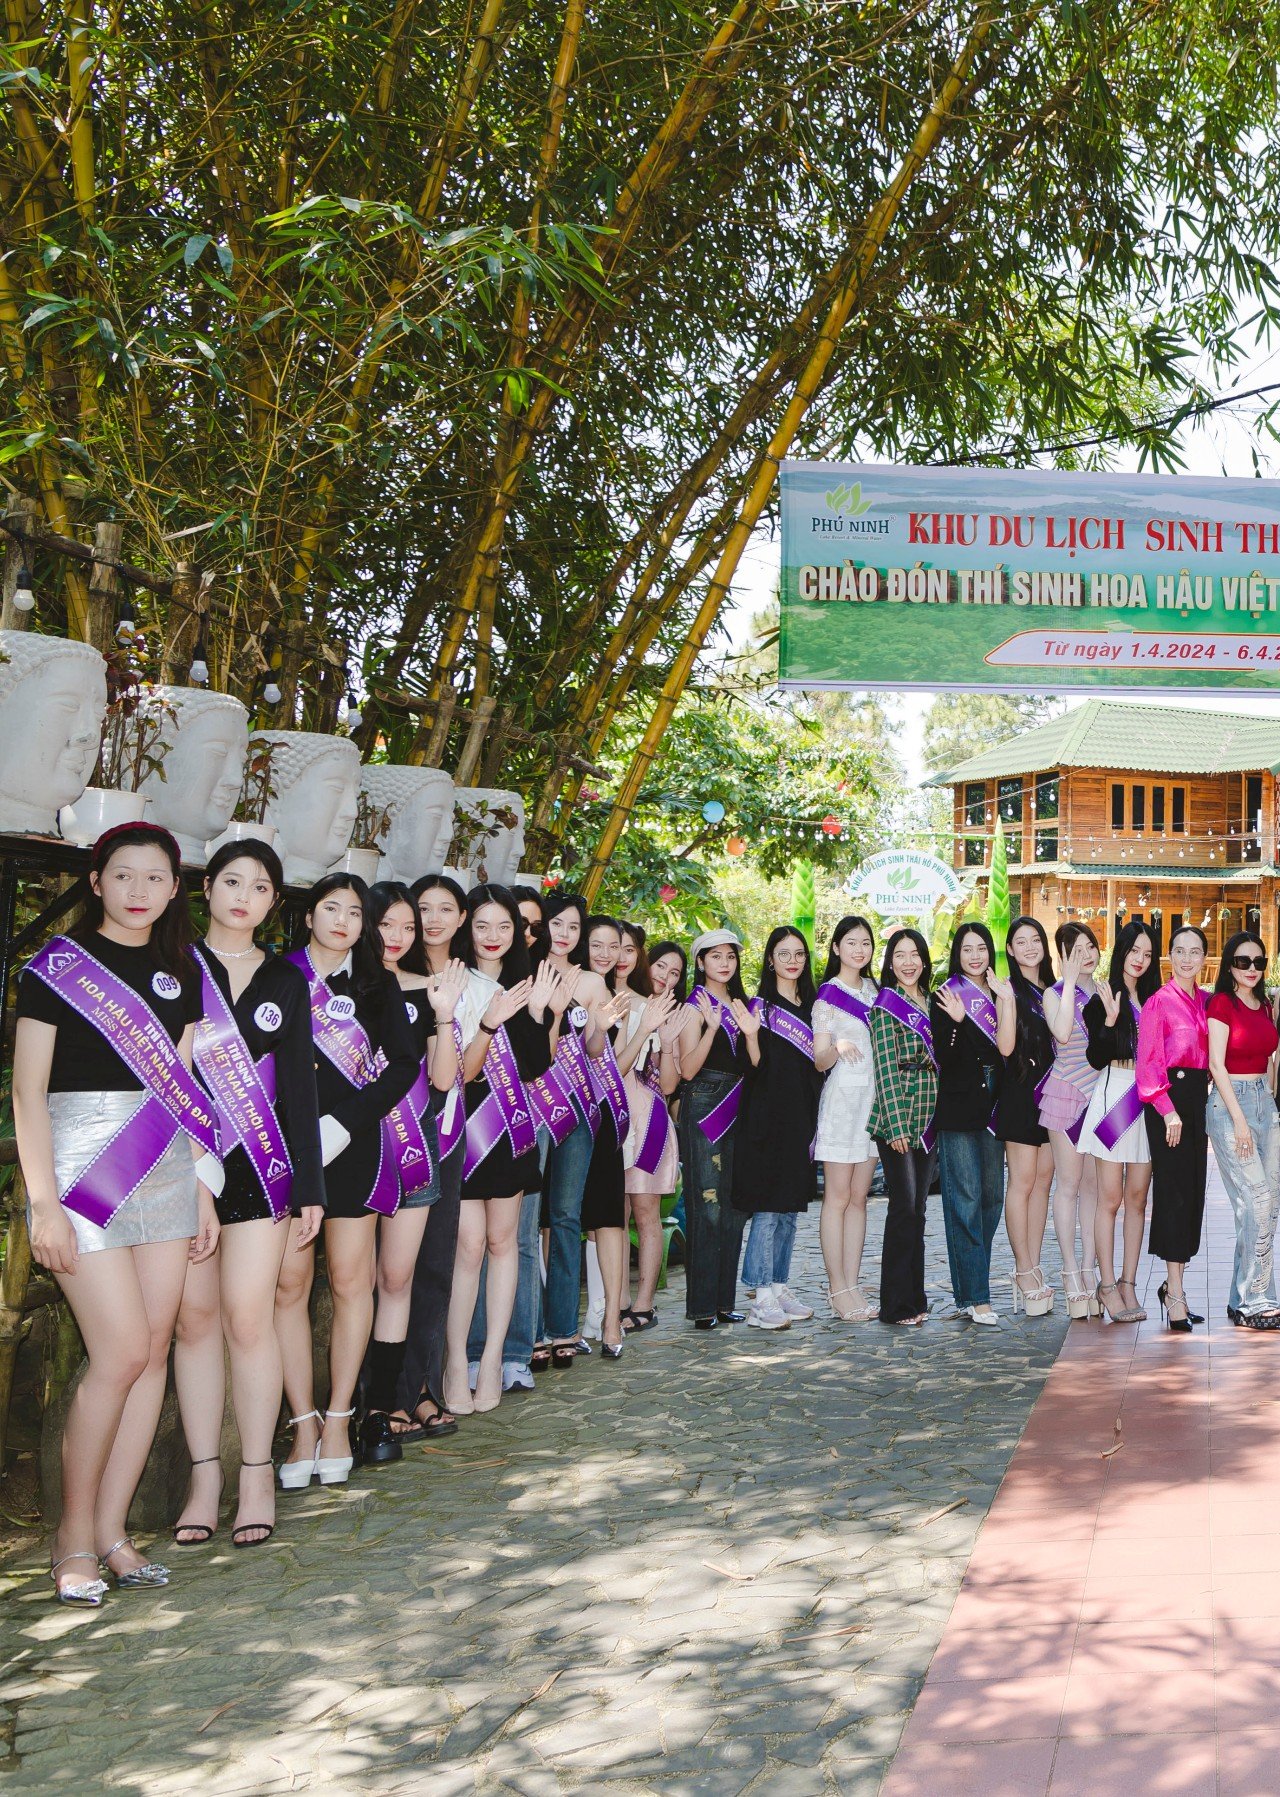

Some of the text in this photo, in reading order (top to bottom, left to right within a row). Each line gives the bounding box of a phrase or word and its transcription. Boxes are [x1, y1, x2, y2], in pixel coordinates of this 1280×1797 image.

[812, 515, 890, 534] PHÚ NINH
[907, 512, 979, 547] KHU
[988, 513, 1036, 548] DU
[1045, 515, 1126, 558] LỊCH
[1146, 518, 1223, 553] SINH
[799, 559, 880, 602] CHÀO
[886, 561, 950, 604] ĐÓN
[957, 563, 1005, 605] THÍ
[1012, 571, 1084, 606] SINH
[1090, 573, 1148, 608] HOA
[1156, 567, 1213, 618] HẬU
[1044, 640, 1067, 657] Từ
[1074, 641, 1120, 661] ngày
[1131, 642, 1216, 660] 1.4.2024
[851, 874, 863, 891] KHU
[888, 854, 904, 864] SINH
[943, 873, 957, 892] NINH
[876, 891, 931, 905] PHÚ NINH
[156, 976, 178, 992] 099
[260, 1006, 280, 1027] 136
[311, 1004, 331, 1027] HOA
[330, 1000, 352, 1015] 080
[724, 1016, 739, 1031] HOA
[776, 1017, 792, 1031] HOA
[984, 1012, 998, 1029] HOA
[76, 976, 213, 1128] HOA HẬU VIỆT NAM THỜI ĐẠI
[317, 1030, 339, 1051] MISS
[91, 1007, 183, 1116] MISS VIETNAM ERA 2024
[156, 1039, 177, 1067] SINH
[235, 1060, 256, 1088] SINH
[497, 1063, 511, 1088] THỜI
[506, 1087, 518, 1106] ĐẠI
[561, 1045, 577, 1065] NAM
[573, 1065, 586, 1086] THỜI
[582, 1085, 592, 1101] ĐẠI
[211, 1042, 273, 1155] VIỆT NAM THỜI ĐẠI
[541, 1089, 556, 1106] ĐẠI
[613, 1089, 623, 1107] ĐẠI
[222, 1090, 239, 1111] ERA
[234, 1111, 251, 1133] 2024
[395, 1121, 410, 1144] ĐẠI
